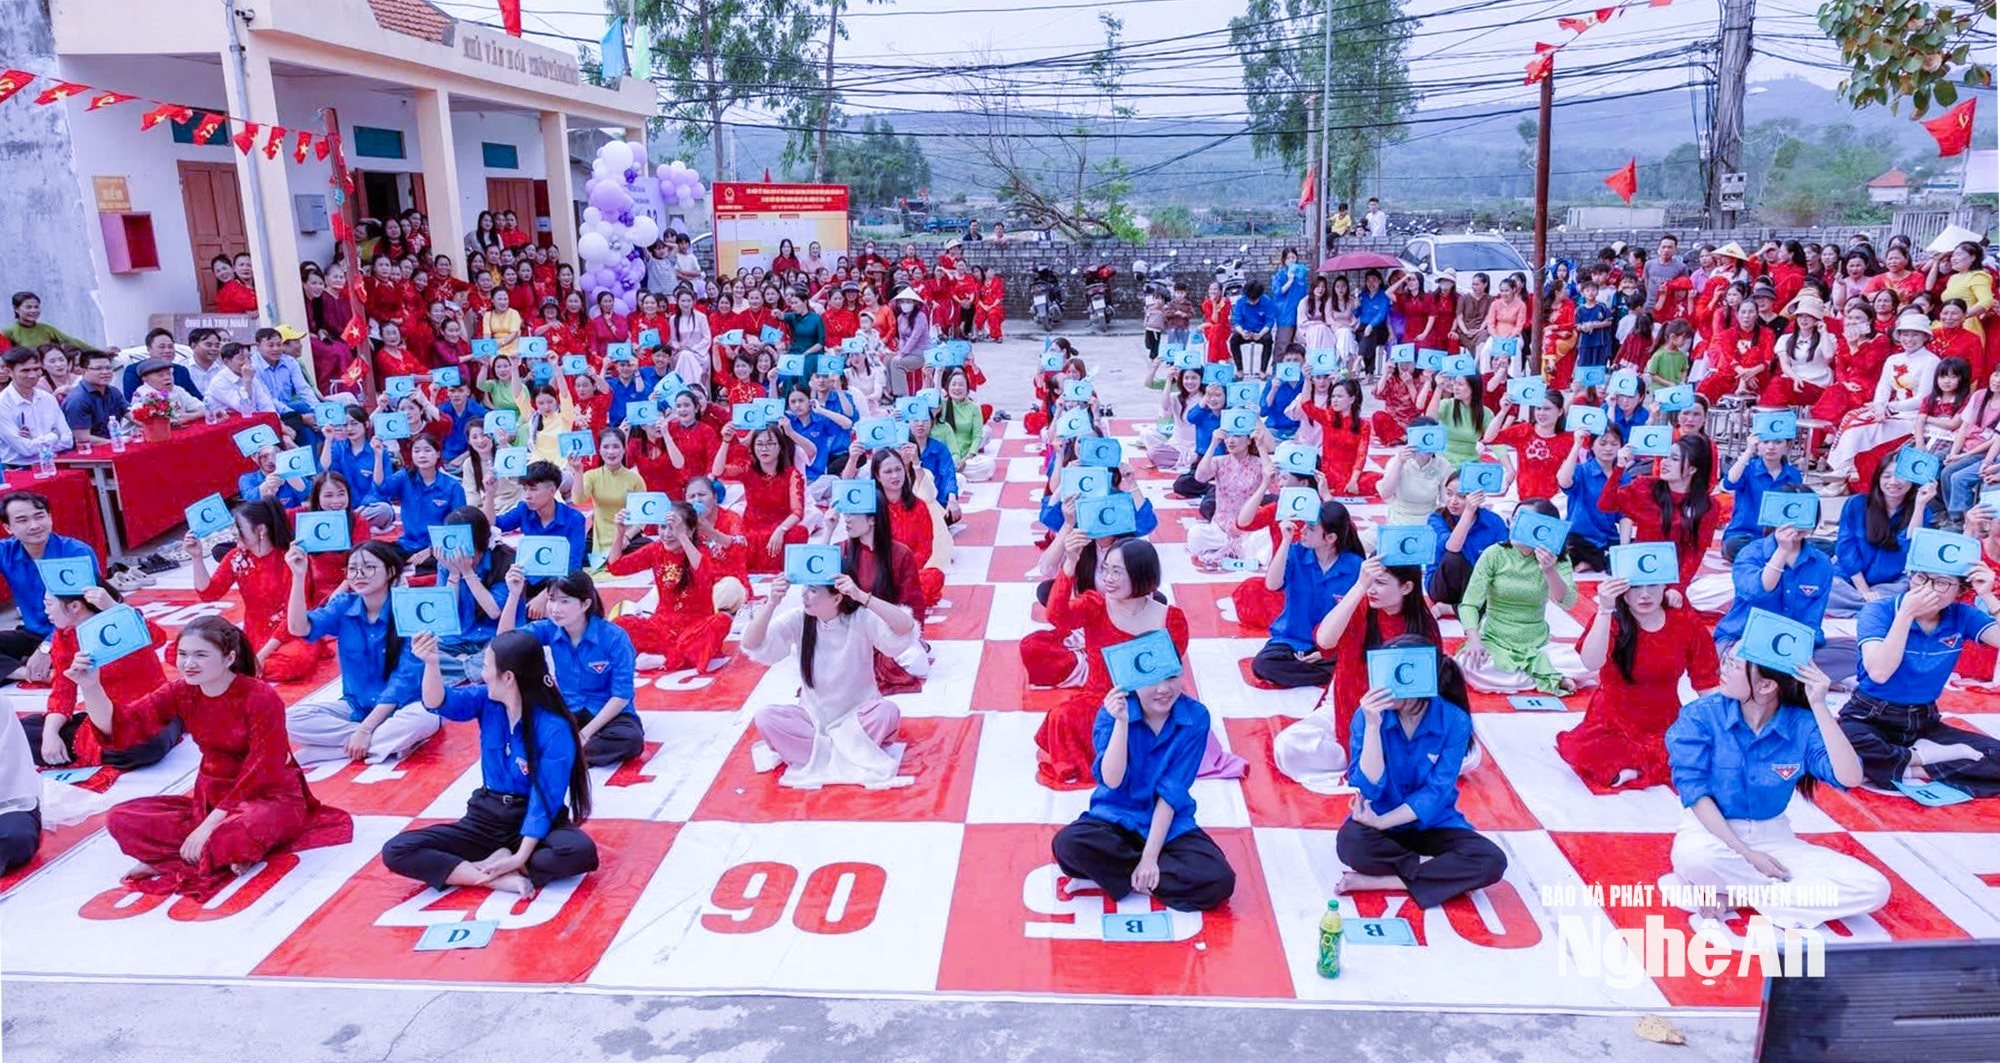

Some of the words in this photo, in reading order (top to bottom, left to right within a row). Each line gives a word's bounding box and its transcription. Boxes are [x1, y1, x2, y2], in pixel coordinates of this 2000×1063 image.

[644, 333, 652, 342] C
[767, 331, 775, 340] C
[481, 343, 489, 352] C
[529, 342, 538, 352] C
[615, 347, 624, 356] C
[1166, 348, 1175, 357] C
[1501, 342, 1510, 351] C
[935, 352, 943, 362] C
[1317, 353, 1327, 365] C
[1398, 348, 1406, 358] C
[572, 360, 580, 369] C
[786, 359, 796, 371] C
[828, 360, 836, 370] C
[1048, 358, 1056, 367] C
[1183, 354, 1192, 365] C
[1428, 354, 1438, 365] C
[1455, 360, 1464, 371] C
[442, 372, 450, 382] C
[1214, 370, 1225, 381] C
[1284, 368, 1292, 377] C
[1586, 371, 1595, 381] C
[395, 381, 404, 392] C
[662, 380, 671, 391] C
[1619, 379, 1629, 389] C
[1074, 385, 1084, 396] C
[1240, 389, 1250, 400] C
[1522, 387, 1534, 400] C
[1669, 392, 1680, 404] C
[325, 408, 334, 419] C
[637, 408, 646, 419] C
[764, 404, 775, 415] C
[908, 403, 918, 414] C
[495, 415, 506, 427] C
[744, 411, 754, 423] C
[1234, 416, 1244, 429] C
[1582, 413, 1595, 425] C
[386, 420, 397, 432] C
[1068, 418, 1080, 430] C
[1769, 419, 1783, 433] C
[251, 433, 260, 443] C
[871, 427, 884, 440] C
[572, 438, 582, 450] D
[1422, 434, 1433, 446] C
[1644, 434, 1656, 448] C
[1095, 446, 1108, 459] C
[1289, 451, 1303, 465] C
[289, 457, 301, 470] C
[504, 456, 516, 470] C
[1911, 460, 1928, 475] C
[1079, 476, 1093, 492] C
[1478, 472, 1492, 488] C
[847, 489, 860, 504] C
[642, 501, 656, 515] C
[1291, 495, 1307, 511] C
[201, 508, 216, 523] C
[1099, 508, 1115, 525] C
[1783, 503, 1801, 519] C
[314, 522, 330, 541] C
[1533, 525, 1551, 541] C
[442, 534, 457, 550] C
[1400, 537, 1417, 555] C
[535, 547, 551, 565] C
[1938, 544, 1960, 563] C
[806, 556, 823, 574] C
[1638, 554, 1656, 573] C
[59, 569, 75, 586] C
[416, 602, 435, 624] C
[99, 624, 121, 647] C
[1772, 633, 1796, 656] C
[1134, 651, 1156, 674] C
[1394, 663, 1414, 685] C
[1125, 920, 1143, 933] B
[1363, 924, 1386, 936] B
[447, 929, 470, 943] D
